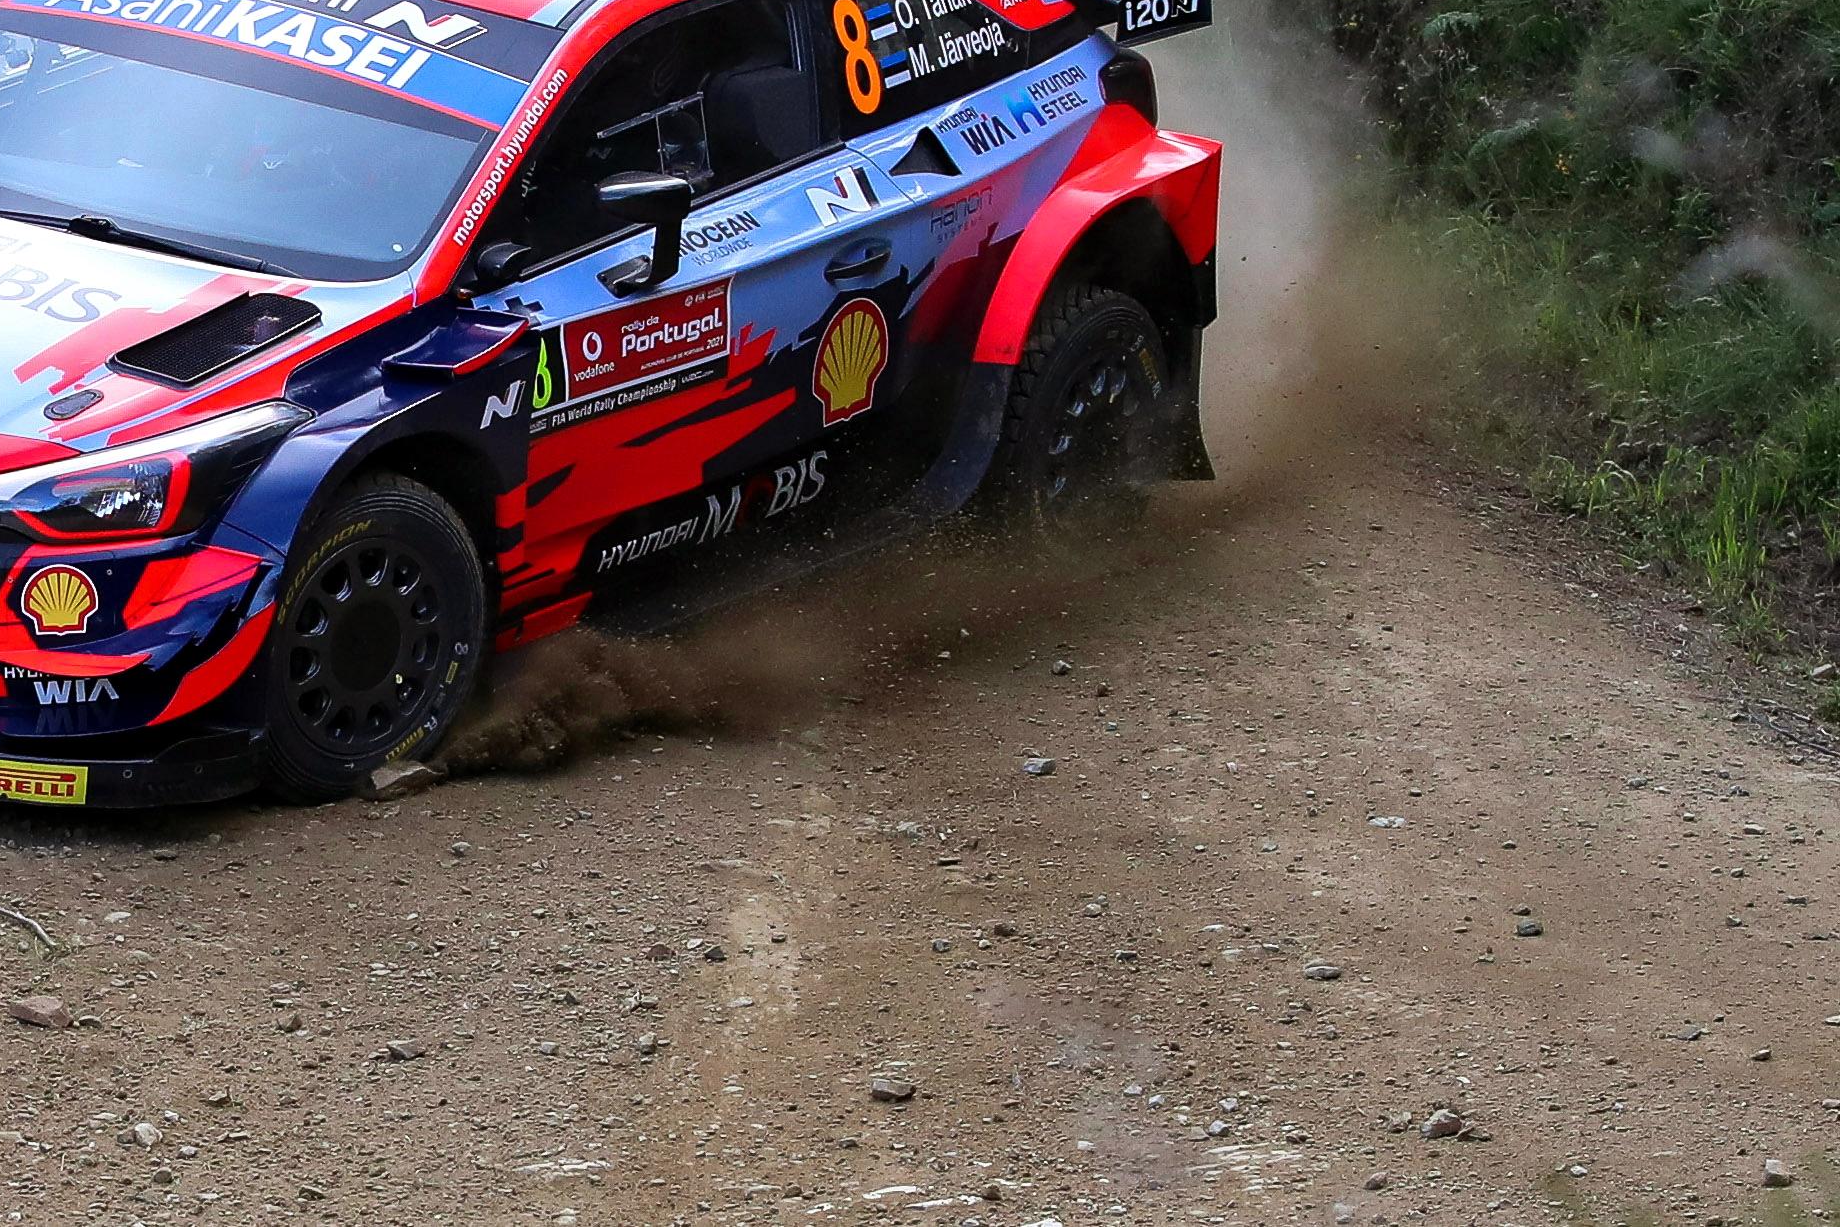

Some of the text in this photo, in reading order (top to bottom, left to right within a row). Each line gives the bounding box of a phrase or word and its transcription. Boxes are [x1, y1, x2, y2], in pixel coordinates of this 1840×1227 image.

[908, 17, 1006, 78] M. Järveoja
[1027, 64, 1089, 102] HYUNDAI
[1040, 90, 1090, 121] STEEL
[935, 105, 979, 134] HYUNDAI
[452, 67, 569, 247] motorsport.hyundai.com
[678, 210, 761, 258] NOCEAN
[621, 315, 660, 334] rally da
[621, 306, 724, 358] Portugal
[574, 361, 615, 382] vodafone
[551, 411, 566, 428] FIA
[567, 403, 593, 423] World
[593, 395, 617, 414] Rally
[616, 377, 678, 407] Championship
[596, 515, 700, 574] HYUNDAI
